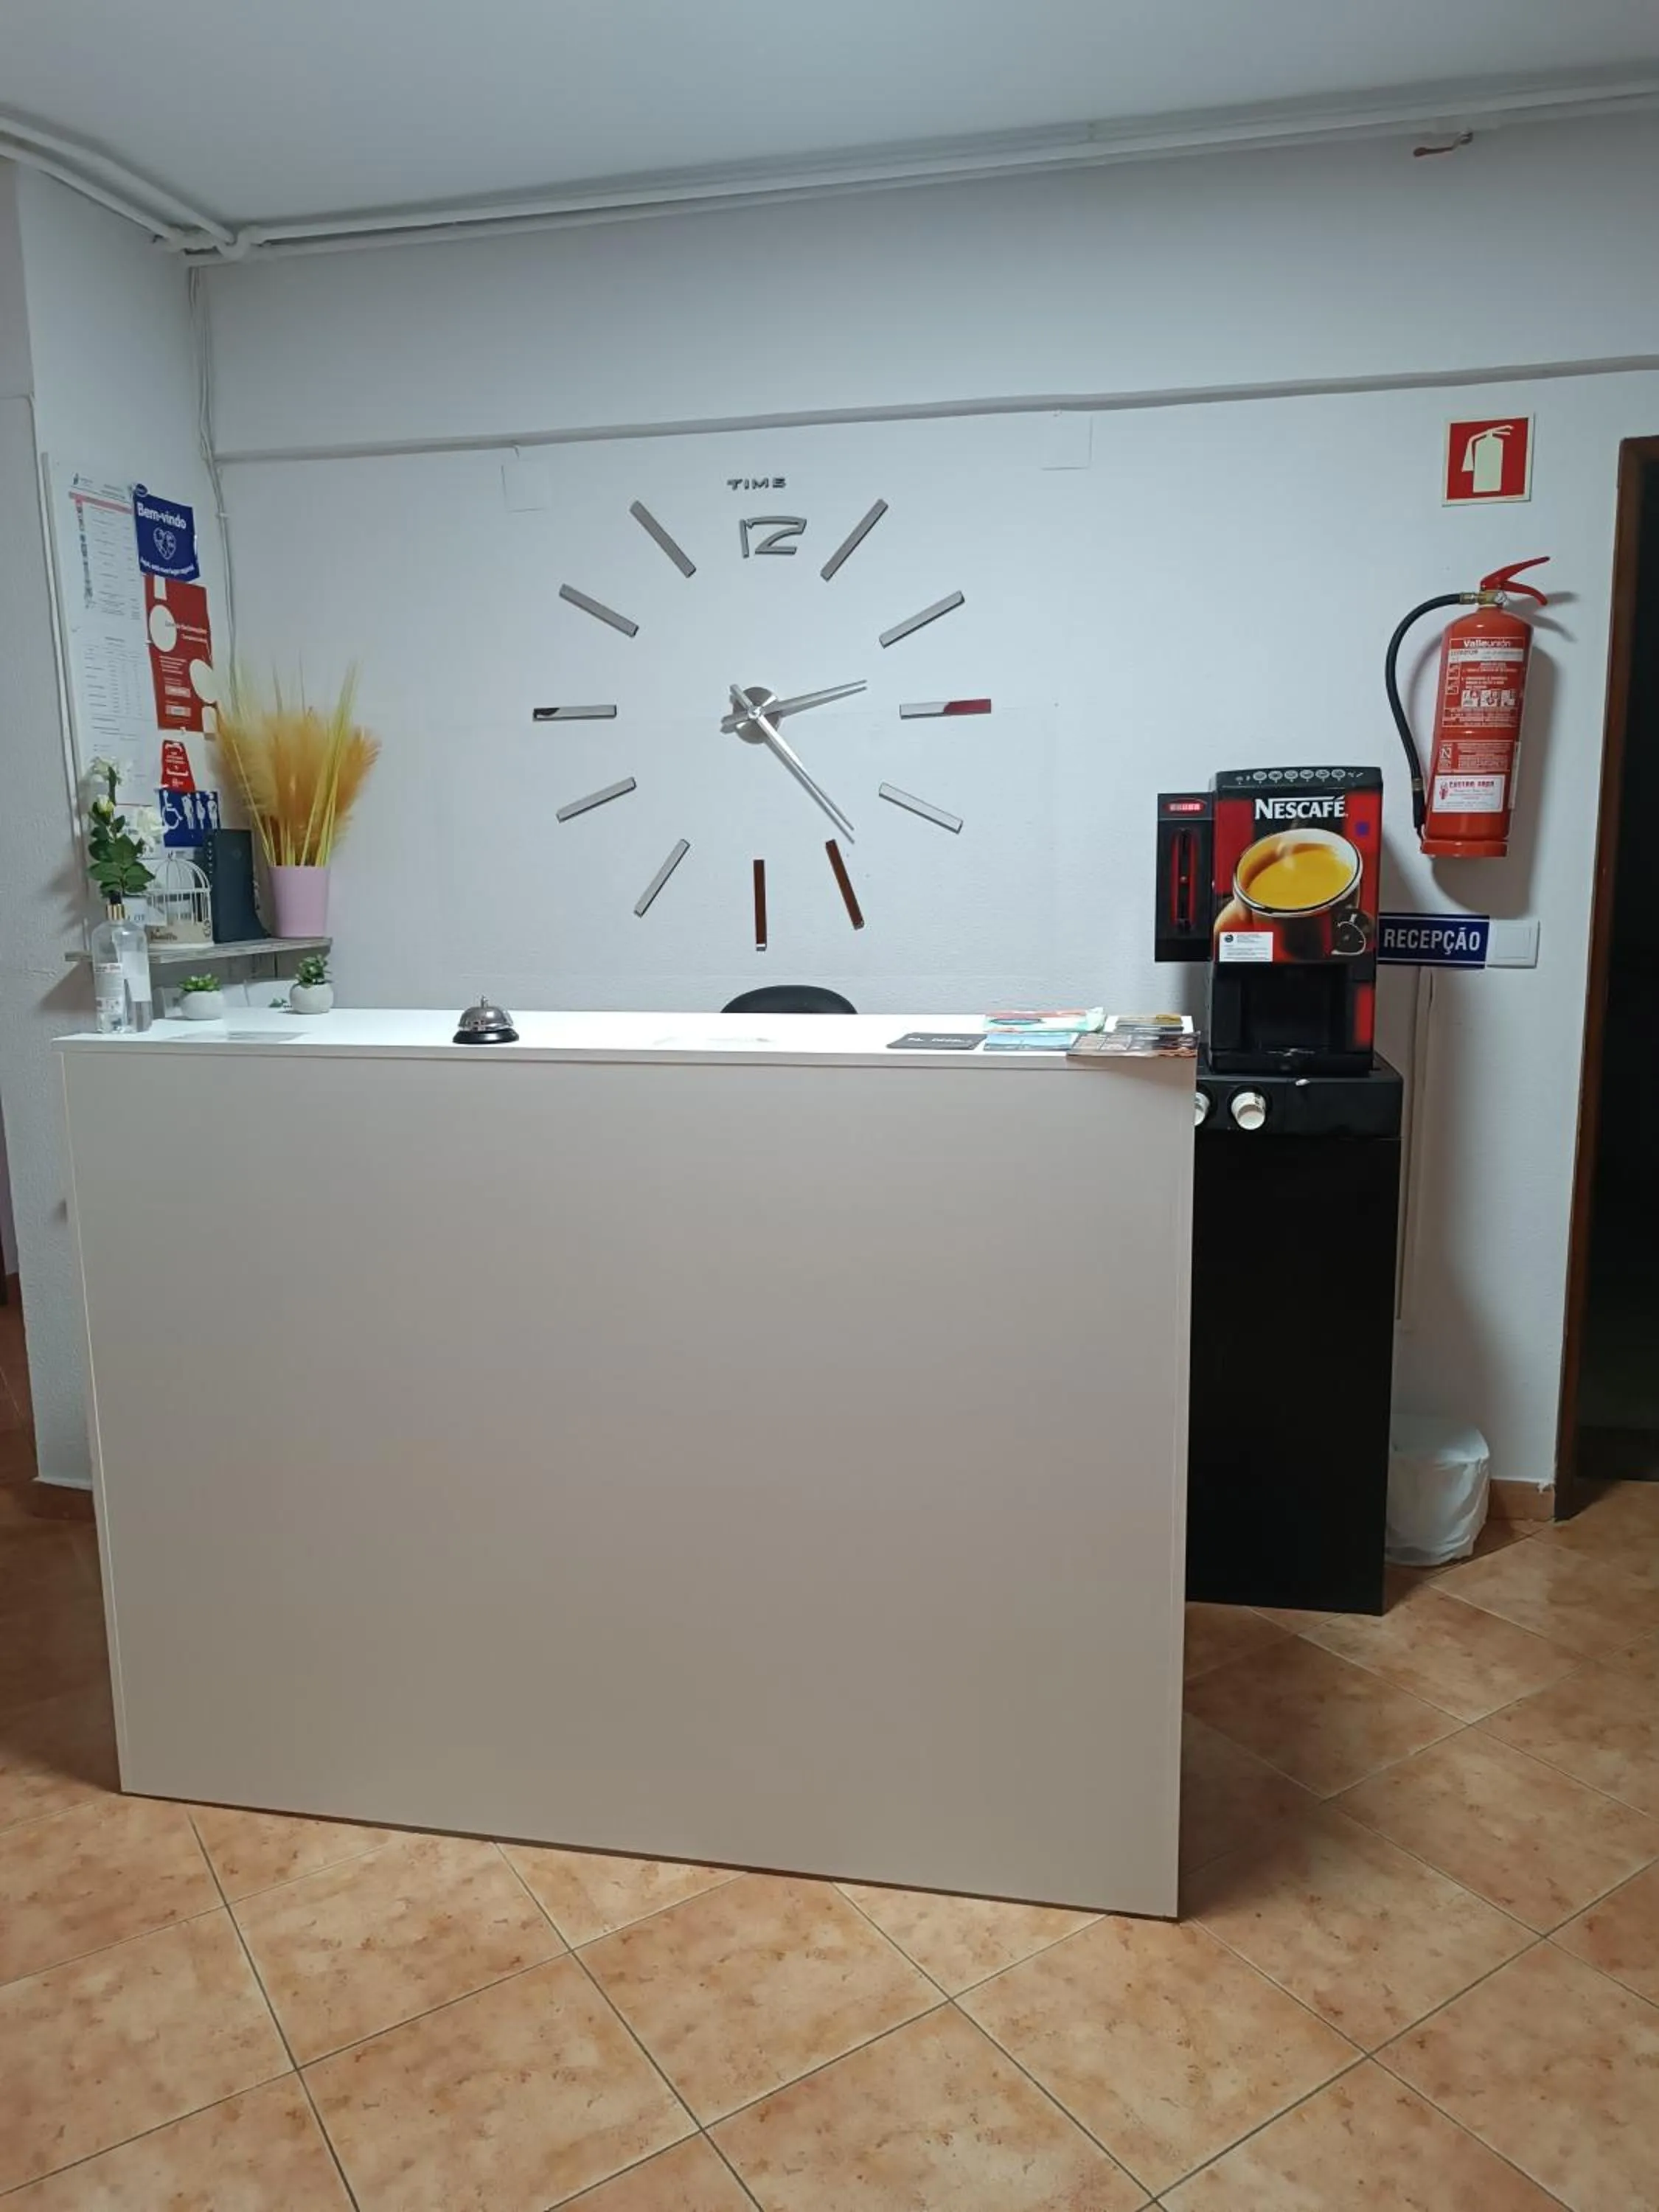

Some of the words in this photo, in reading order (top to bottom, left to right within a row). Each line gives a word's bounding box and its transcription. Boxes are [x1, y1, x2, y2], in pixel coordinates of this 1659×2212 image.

[726, 477, 787, 491] TIME
[136, 501, 187, 529] Bem-vindo
[739, 515, 807, 559] 12
[1254, 795, 1345, 820] NESCAFÉ
[1383, 927, 1481, 956] RECEPÇÃO
